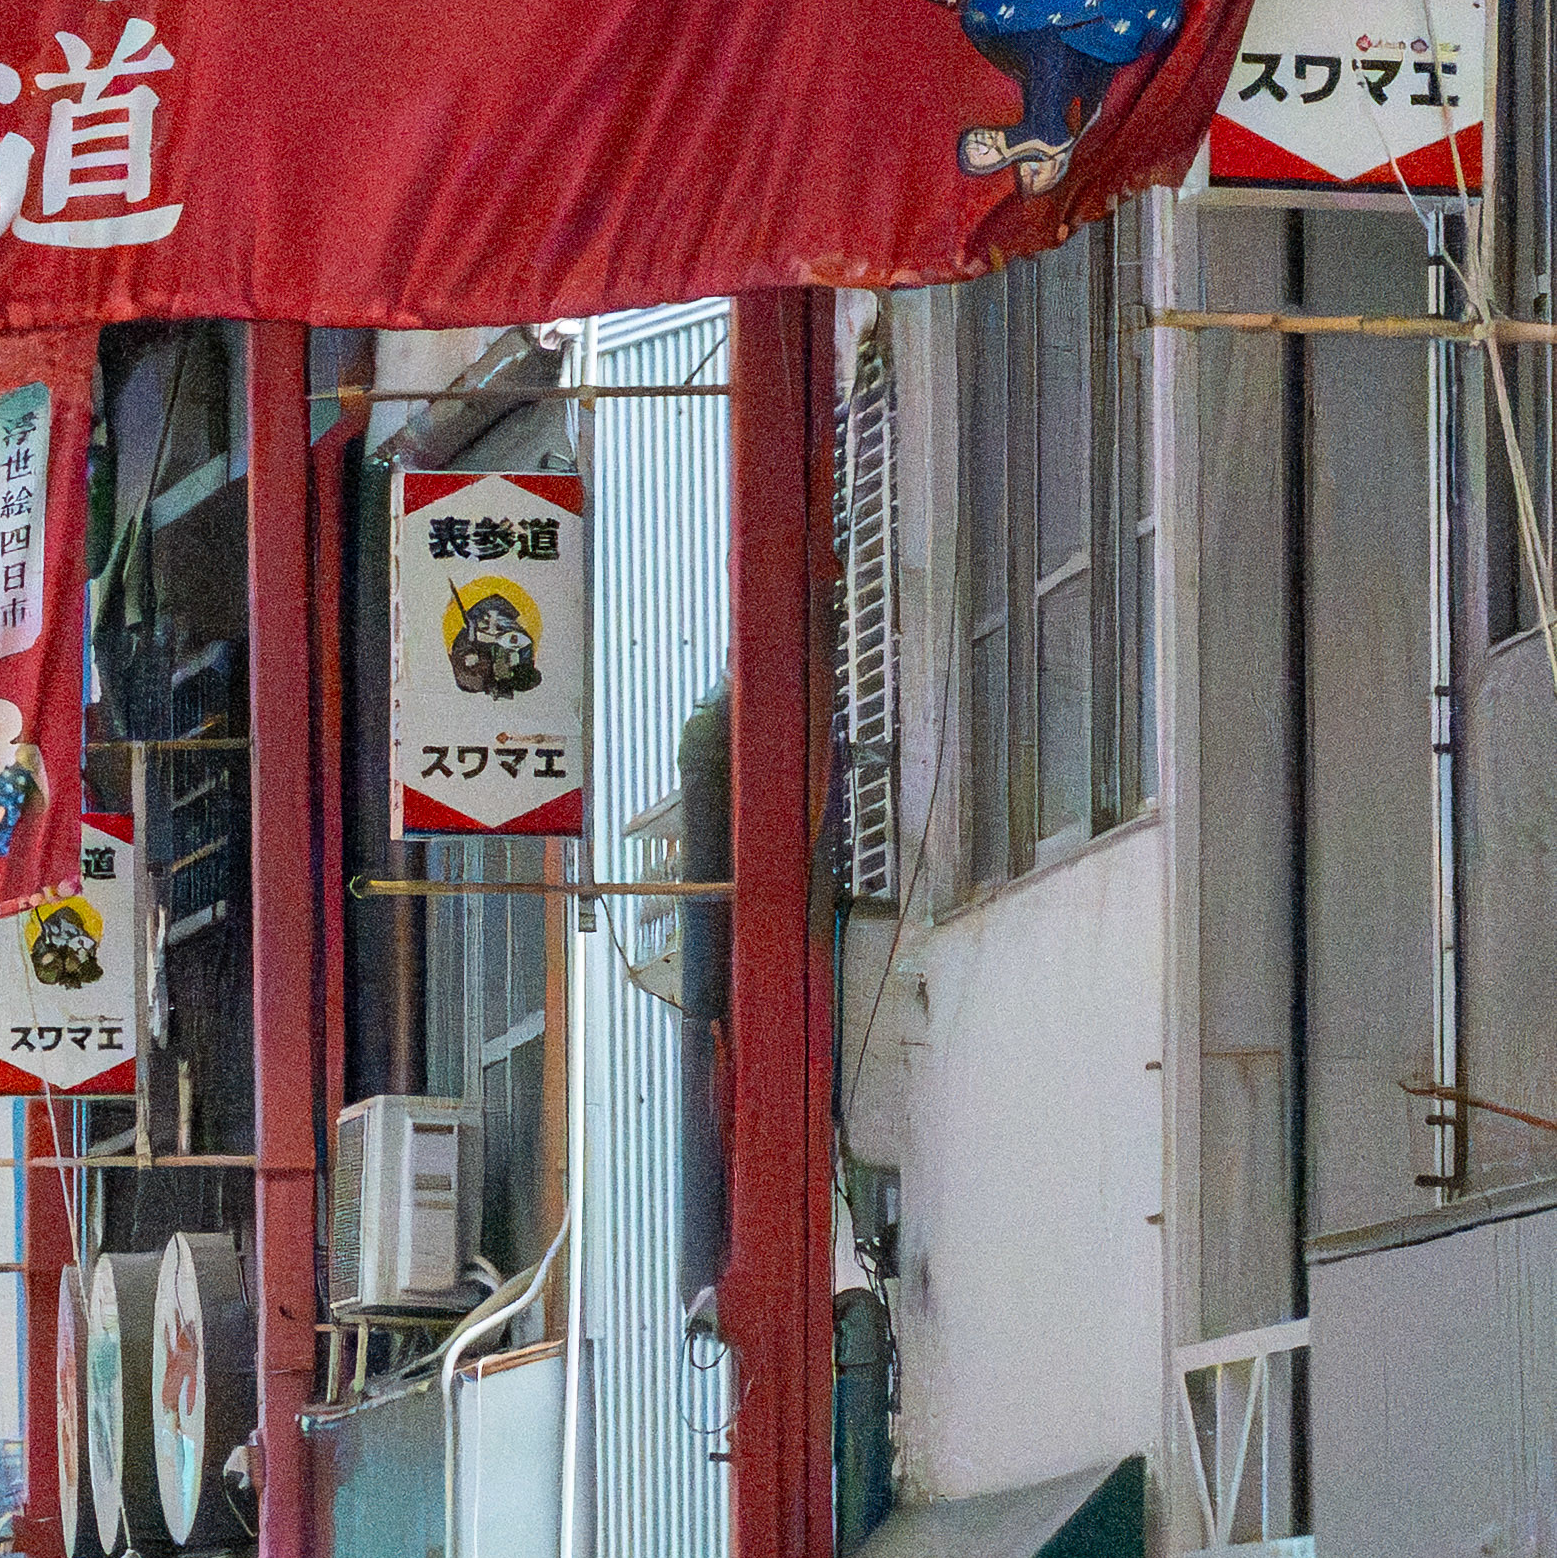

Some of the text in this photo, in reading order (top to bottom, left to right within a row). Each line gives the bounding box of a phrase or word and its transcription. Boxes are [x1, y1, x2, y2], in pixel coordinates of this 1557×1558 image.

[1238, 52, 1460, 108] スワマエ
[0, 410, 37, 629] 浮世絵四日市
[428, 516, 561, 561] 表参道
[420, 744, 567, 781] スワマエ
[9, 1025, 125, 1053] スワマエ
